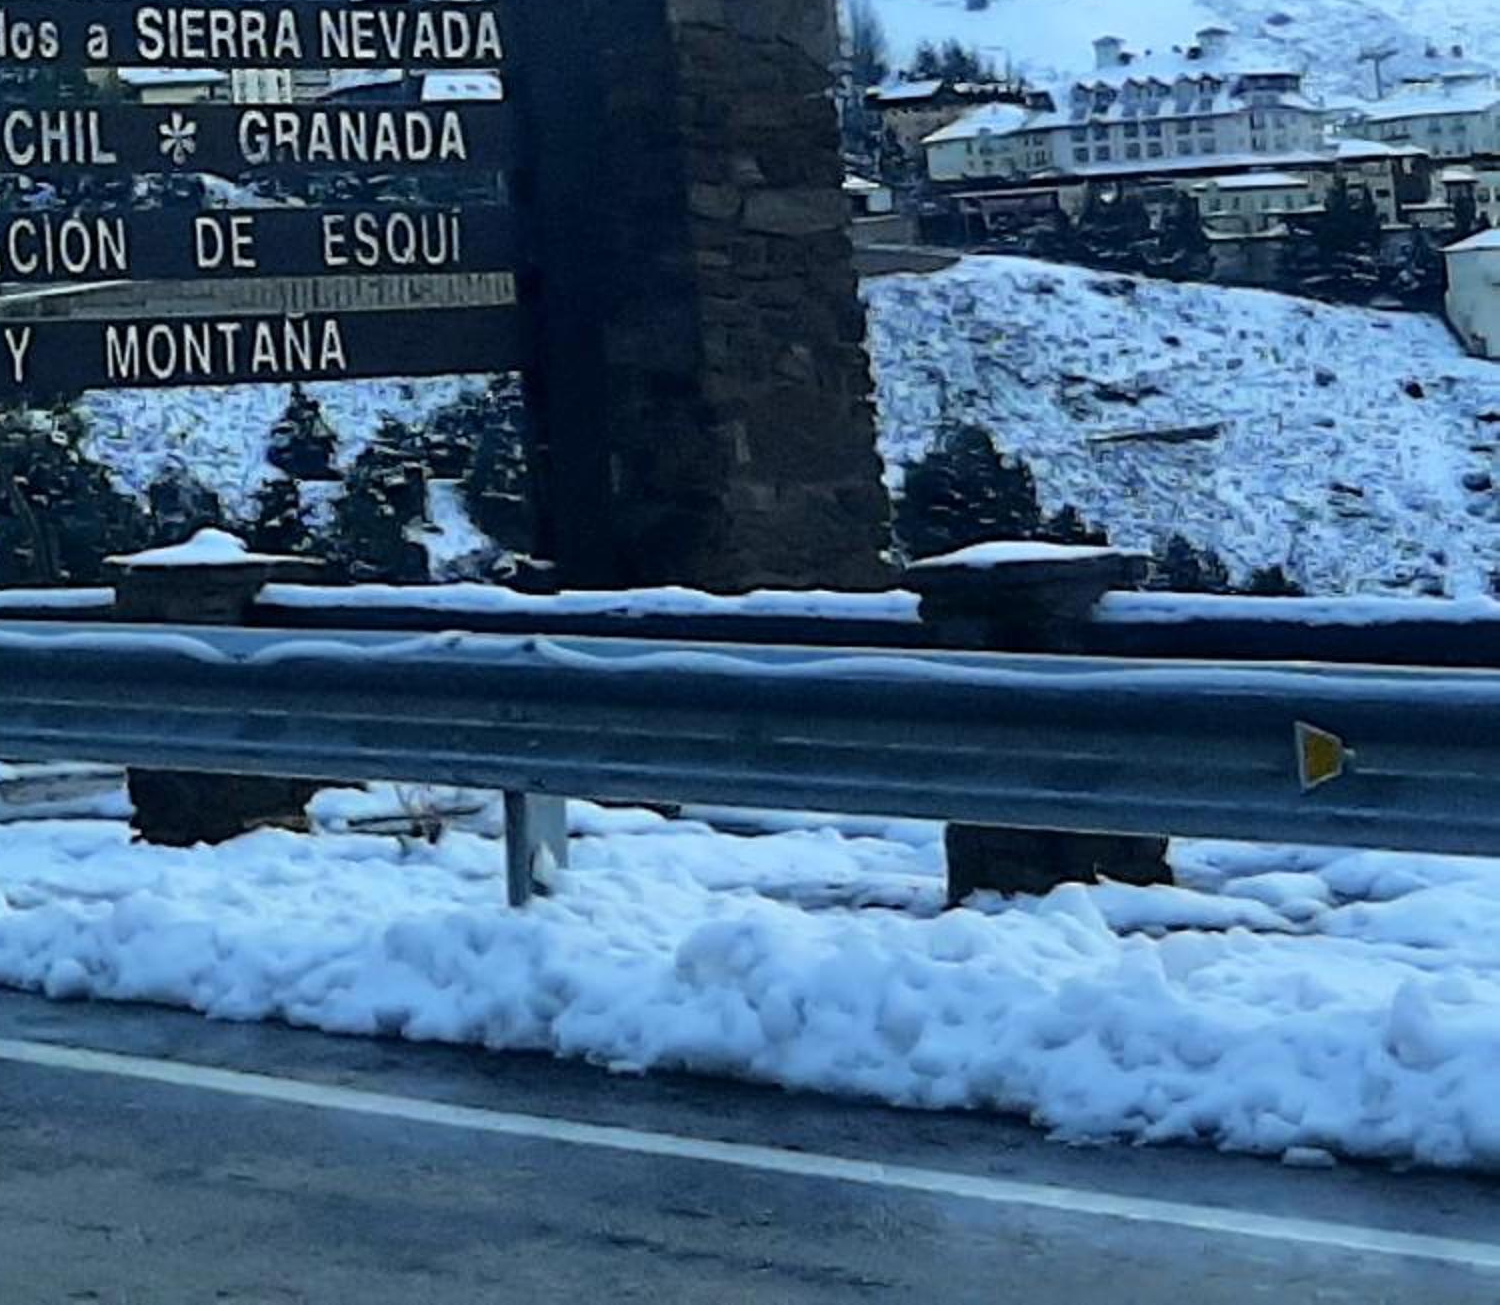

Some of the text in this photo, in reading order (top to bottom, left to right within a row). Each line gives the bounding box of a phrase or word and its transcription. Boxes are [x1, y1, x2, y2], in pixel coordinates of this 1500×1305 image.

[86, 23, 110, 59] a
[137, 7, 302, 60] SIERRA
[320, 10, 504, 60] NEVADA
[238, 110, 467, 164] GRANADA
[195, 216, 257, 268] DE
[5, 326, 31, 382] Y
